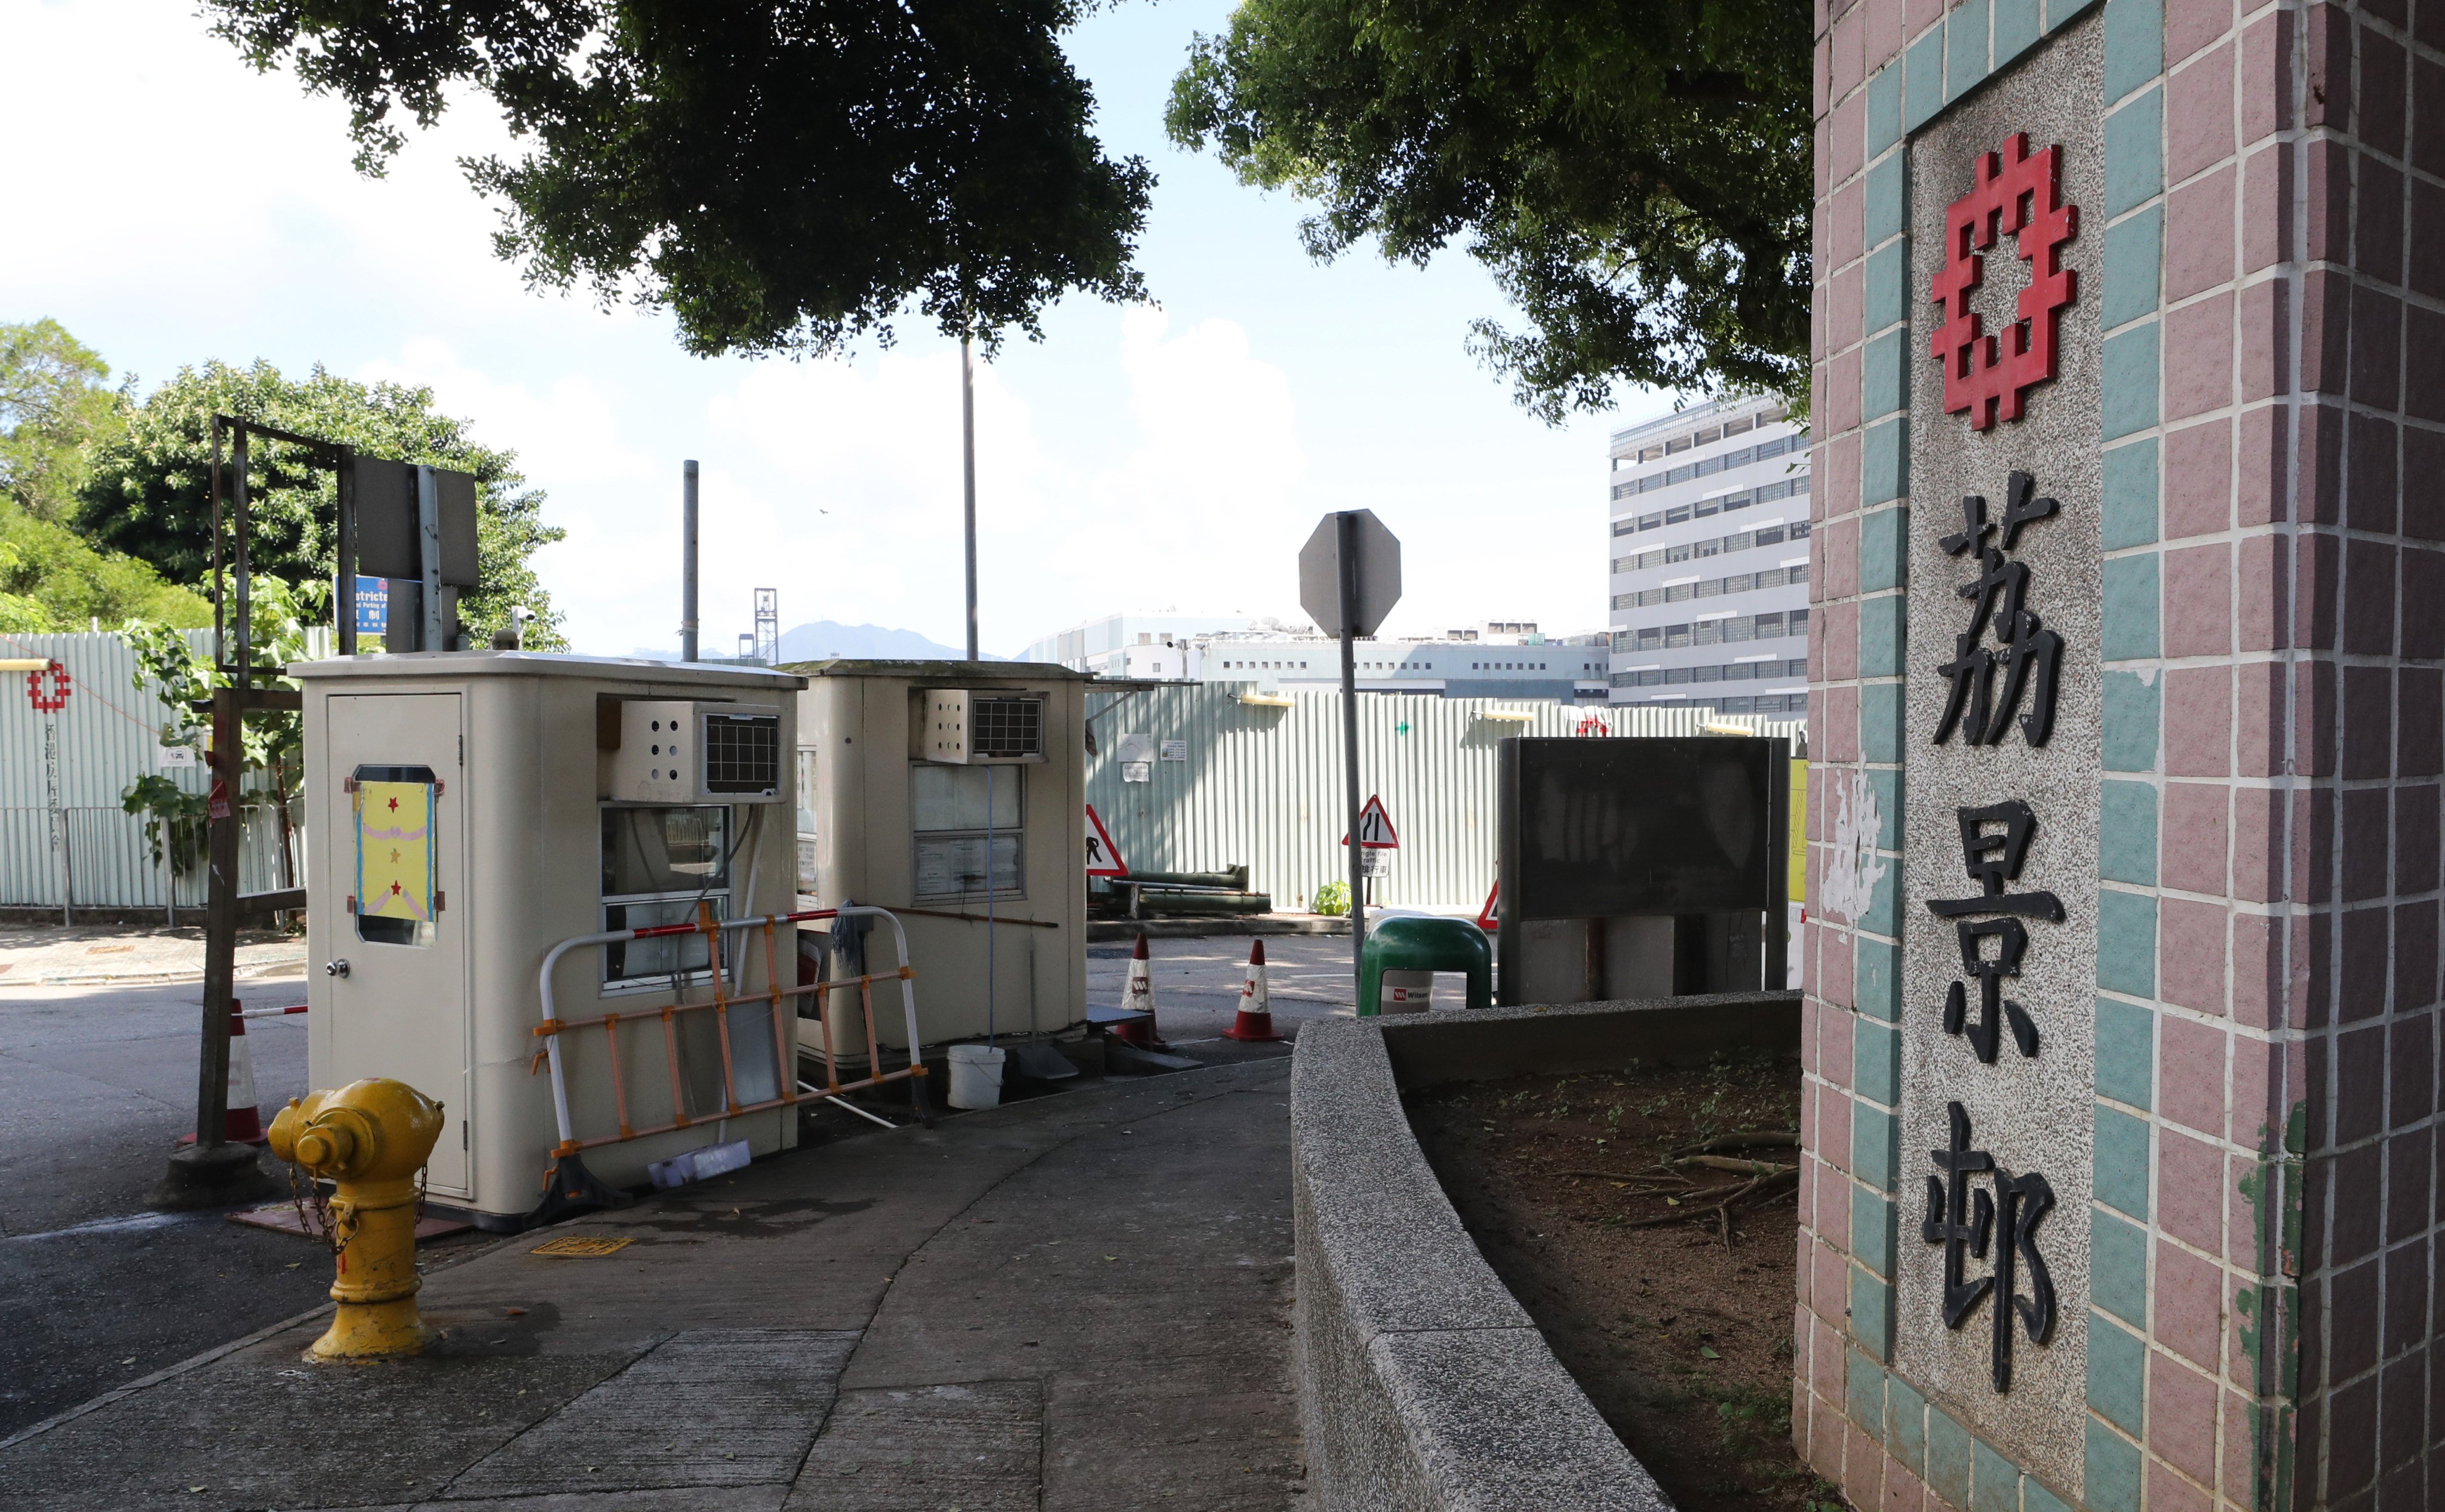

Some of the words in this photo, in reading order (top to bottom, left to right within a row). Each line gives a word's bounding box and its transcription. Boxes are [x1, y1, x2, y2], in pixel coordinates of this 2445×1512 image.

[355, 591, 388, 601] stricte
[1362, 865, 1387, 874] 排行車
[1922, 471, 2066, 1393] 荔景邨
